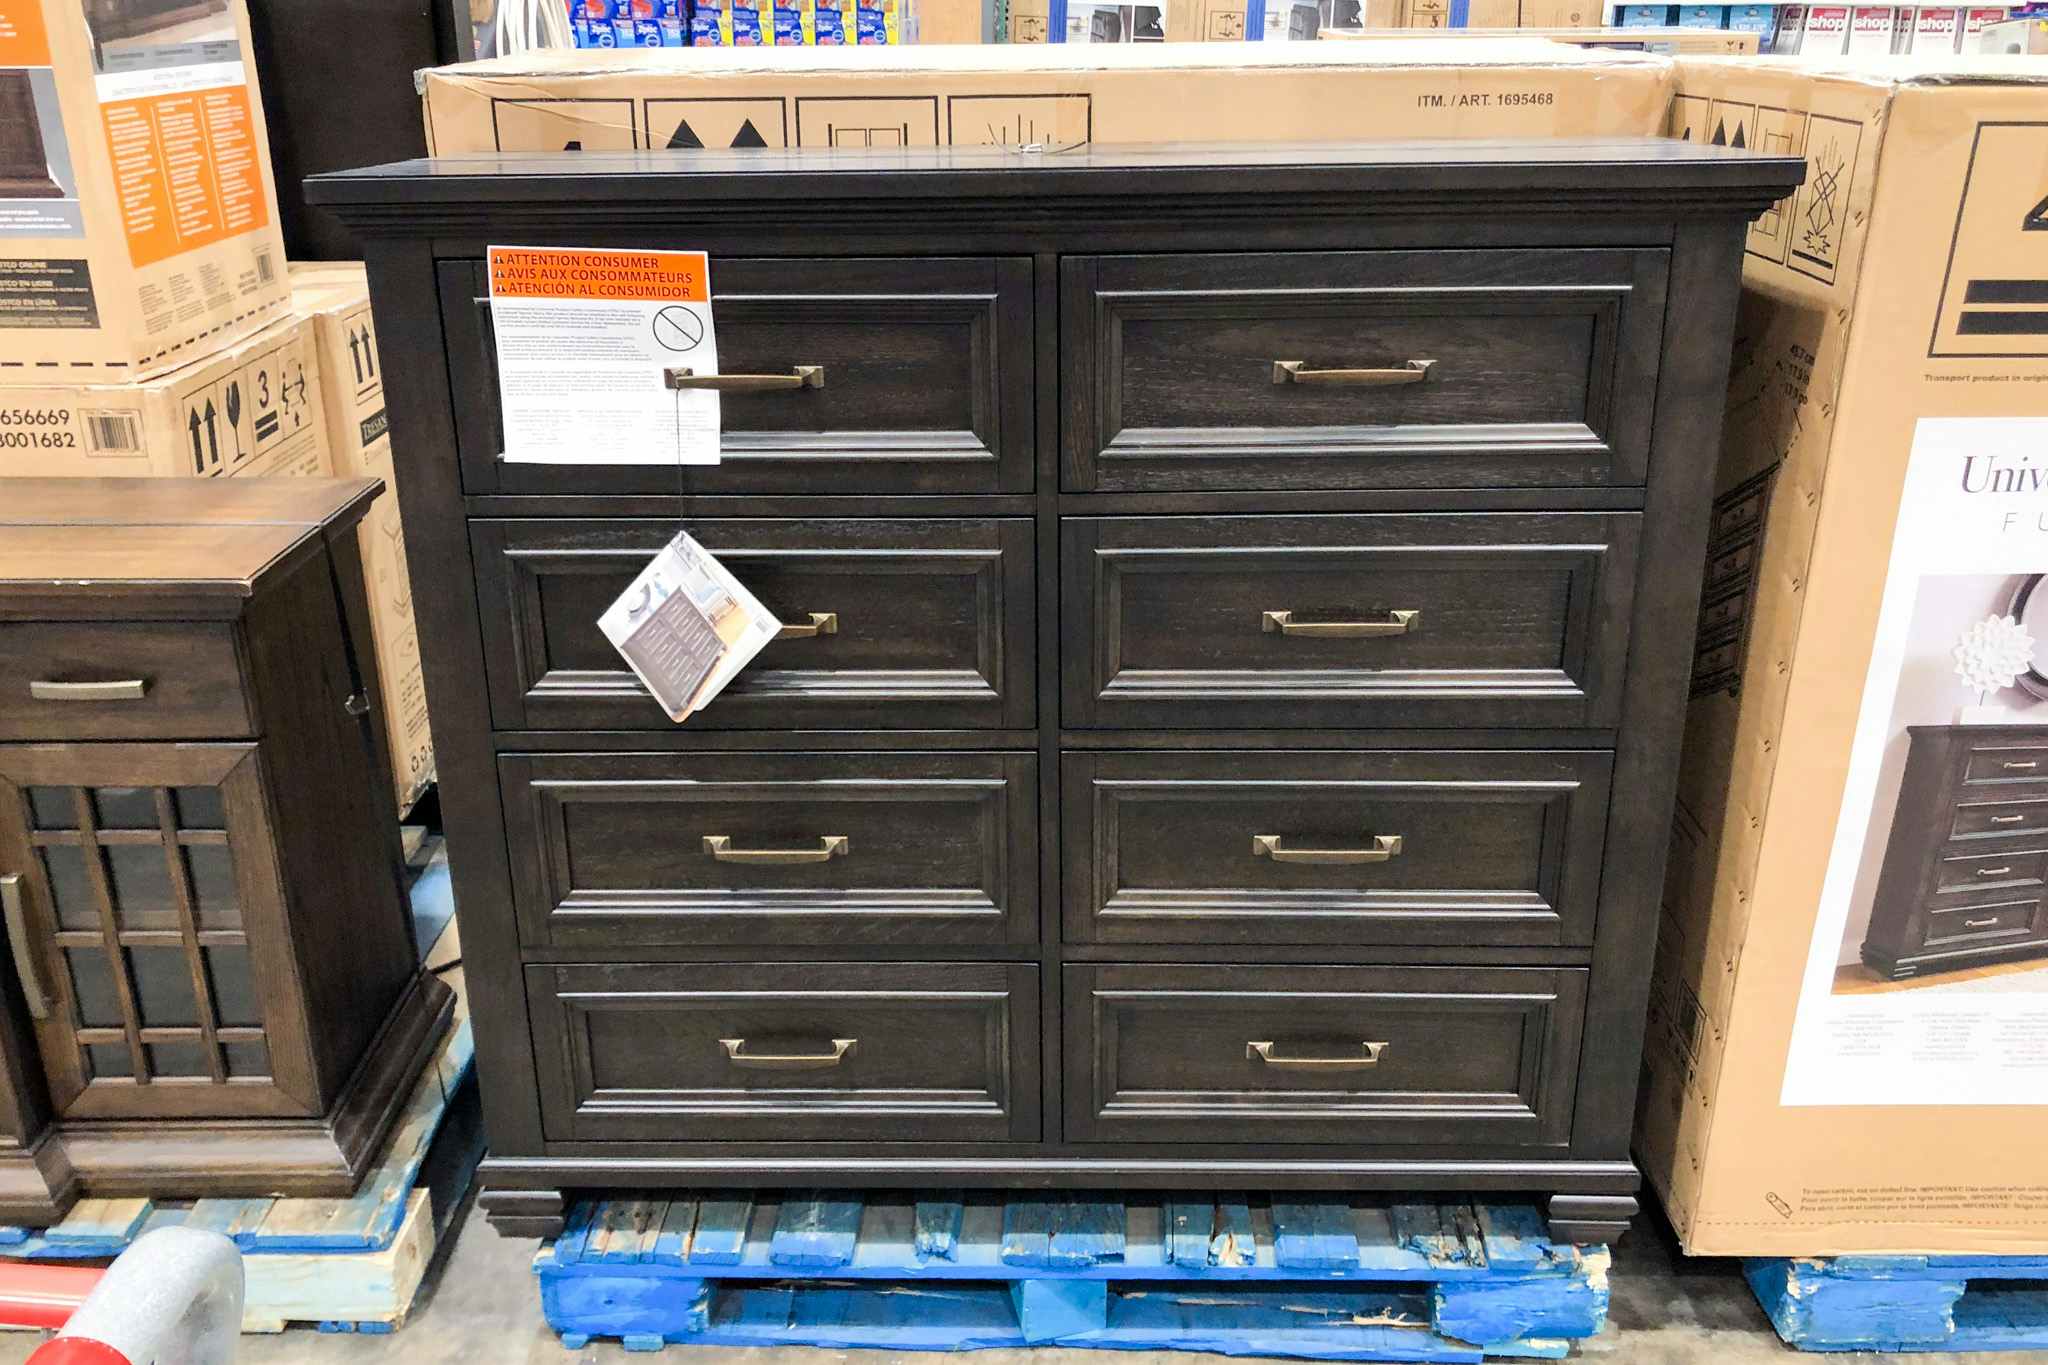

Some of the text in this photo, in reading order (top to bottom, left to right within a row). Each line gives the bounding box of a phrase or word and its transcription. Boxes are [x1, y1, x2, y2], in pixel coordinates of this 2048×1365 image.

[1808, 15, 1844, 32] shop
[1854, 15, 1890, 32] shop
[1918, 16, 1954, 32] shop
[1417, 93, 1553, 107] ITM. / ART. 1695468
[506, 254, 659, 269] ATTENTION CONSUMER
[508, 268, 693, 284] AVIS AUX CONSOMMATEURS
[508, 281, 691, 298] ATENCIÓN AL CONSUMIDOR
[258, 370, 269, 408] 3
[0, 409, 70, 425] 656669
[1962, 455, 2048, 493] Univ
